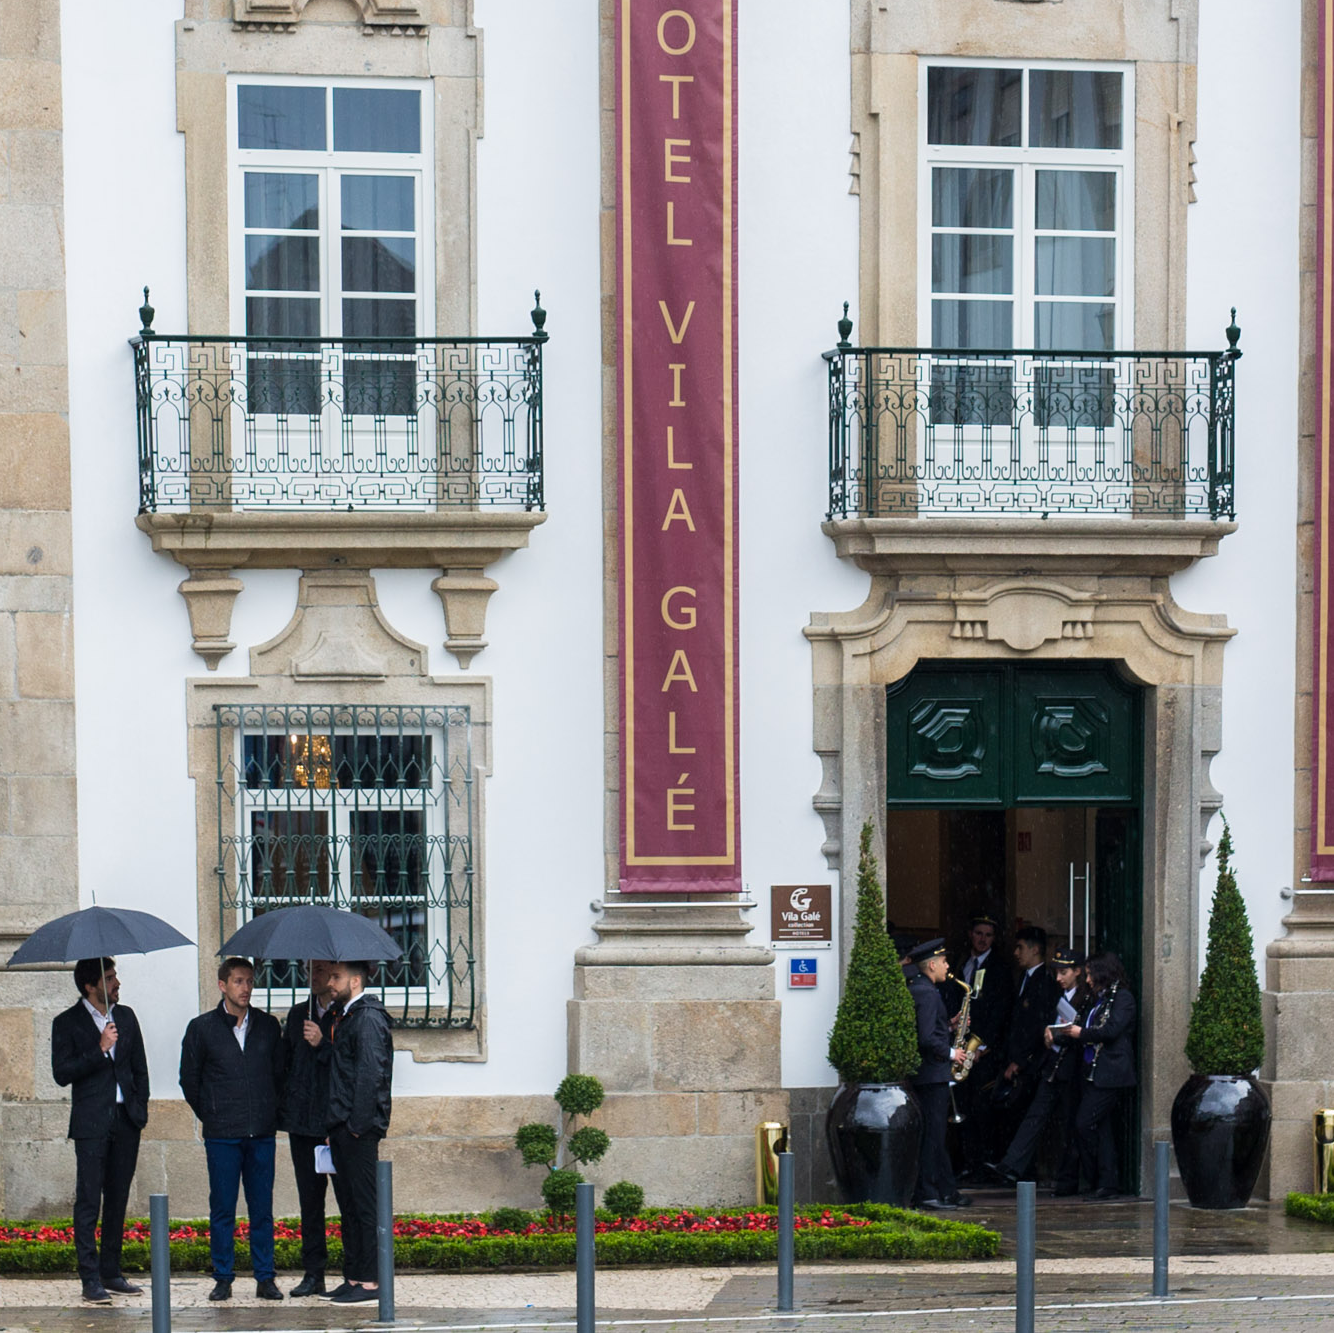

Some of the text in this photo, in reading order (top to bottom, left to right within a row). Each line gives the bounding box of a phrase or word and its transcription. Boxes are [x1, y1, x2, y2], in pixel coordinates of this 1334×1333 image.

[659, 300, 696, 532] VILA
[662, 585, 698, 831] GALÉ
[781, 911, 821, 921] Vila Galé
